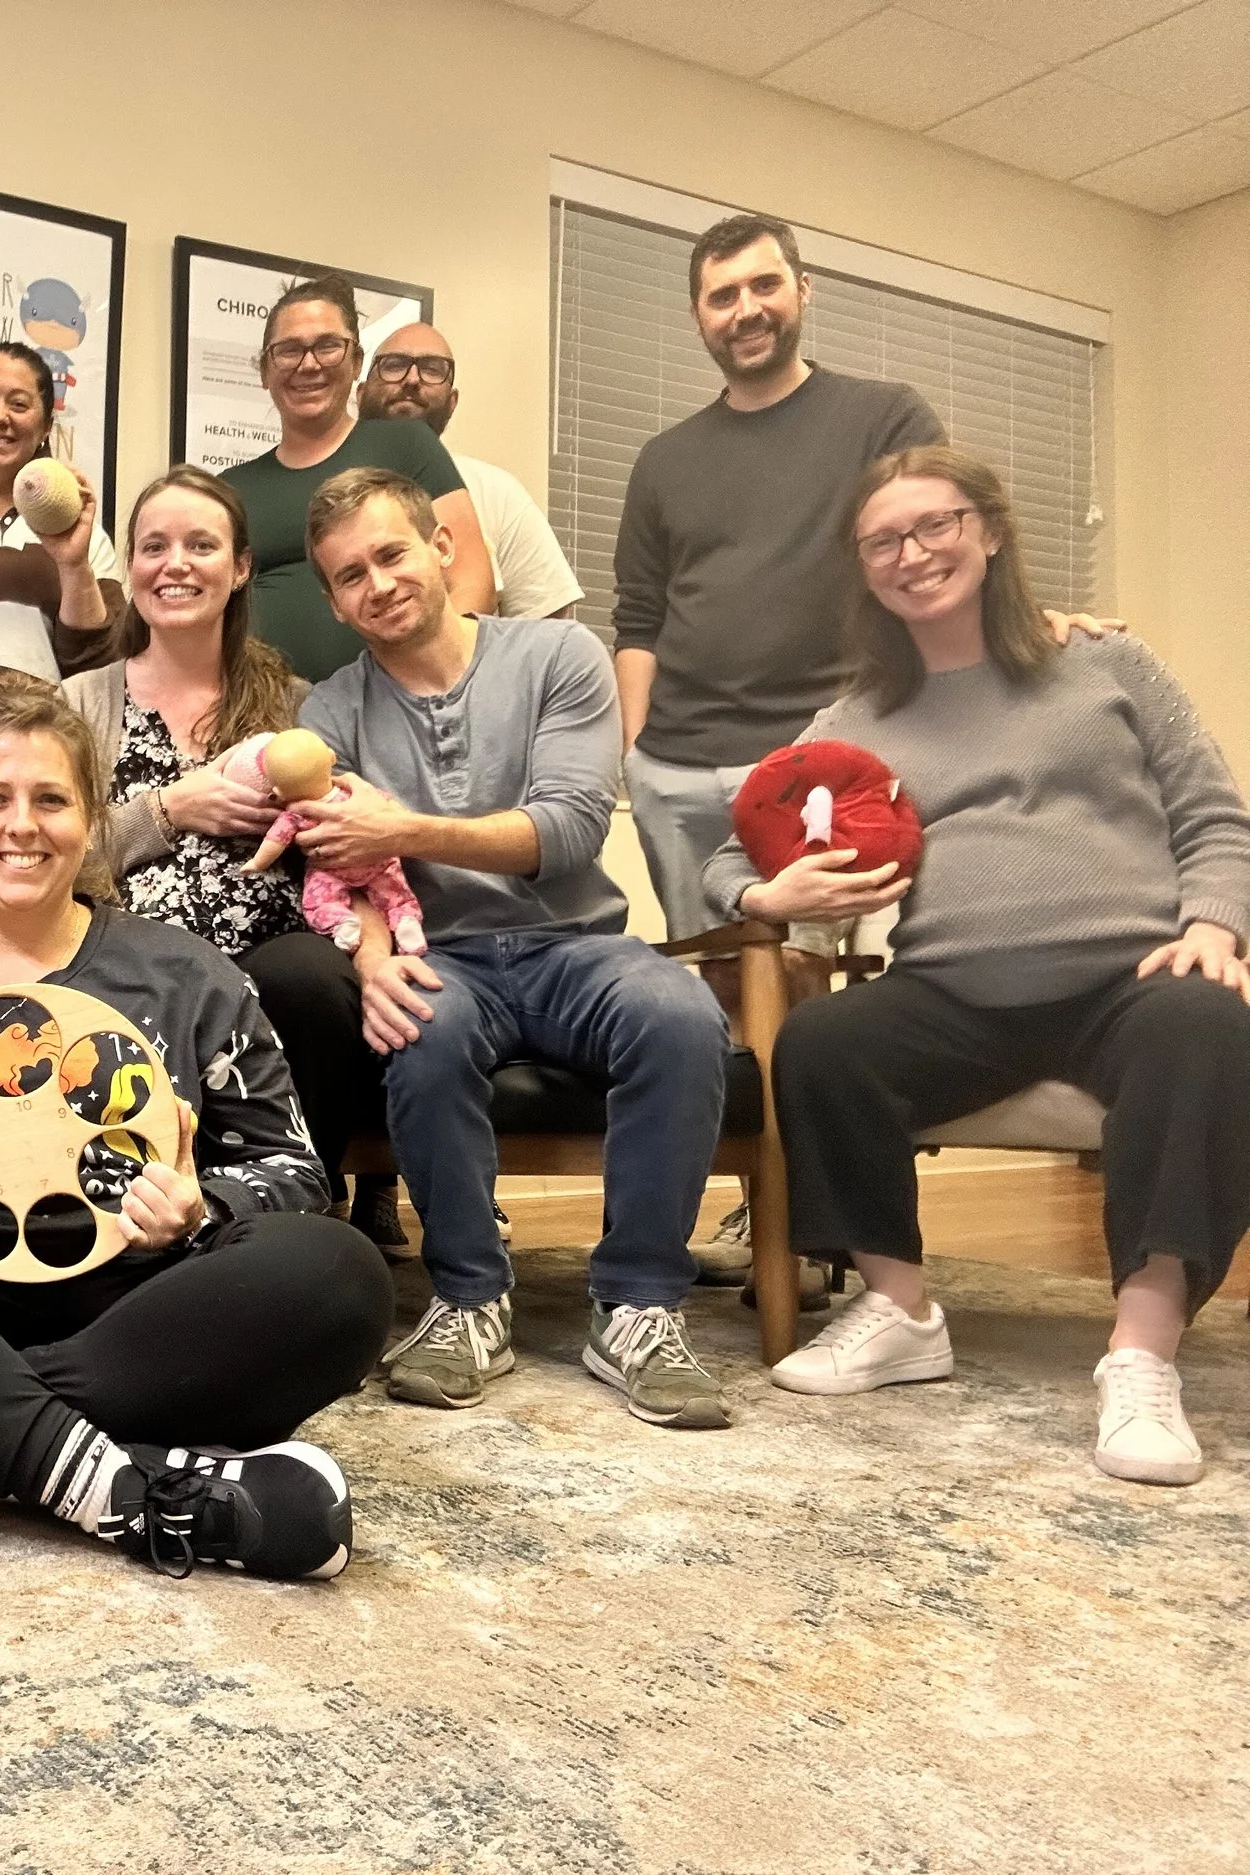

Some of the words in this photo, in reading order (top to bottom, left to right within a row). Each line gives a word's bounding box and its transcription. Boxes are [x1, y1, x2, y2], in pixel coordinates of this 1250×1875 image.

[217, 298, 269, 320] CHIRO
[204, 424, 245, 438] HEALTH
[16, 1099, 32, 1112] 10
[58, 1107, 67, 1119] 9
[66, 1147, 76, 1159] 8
[39, 1178, 49, 1190] 7
